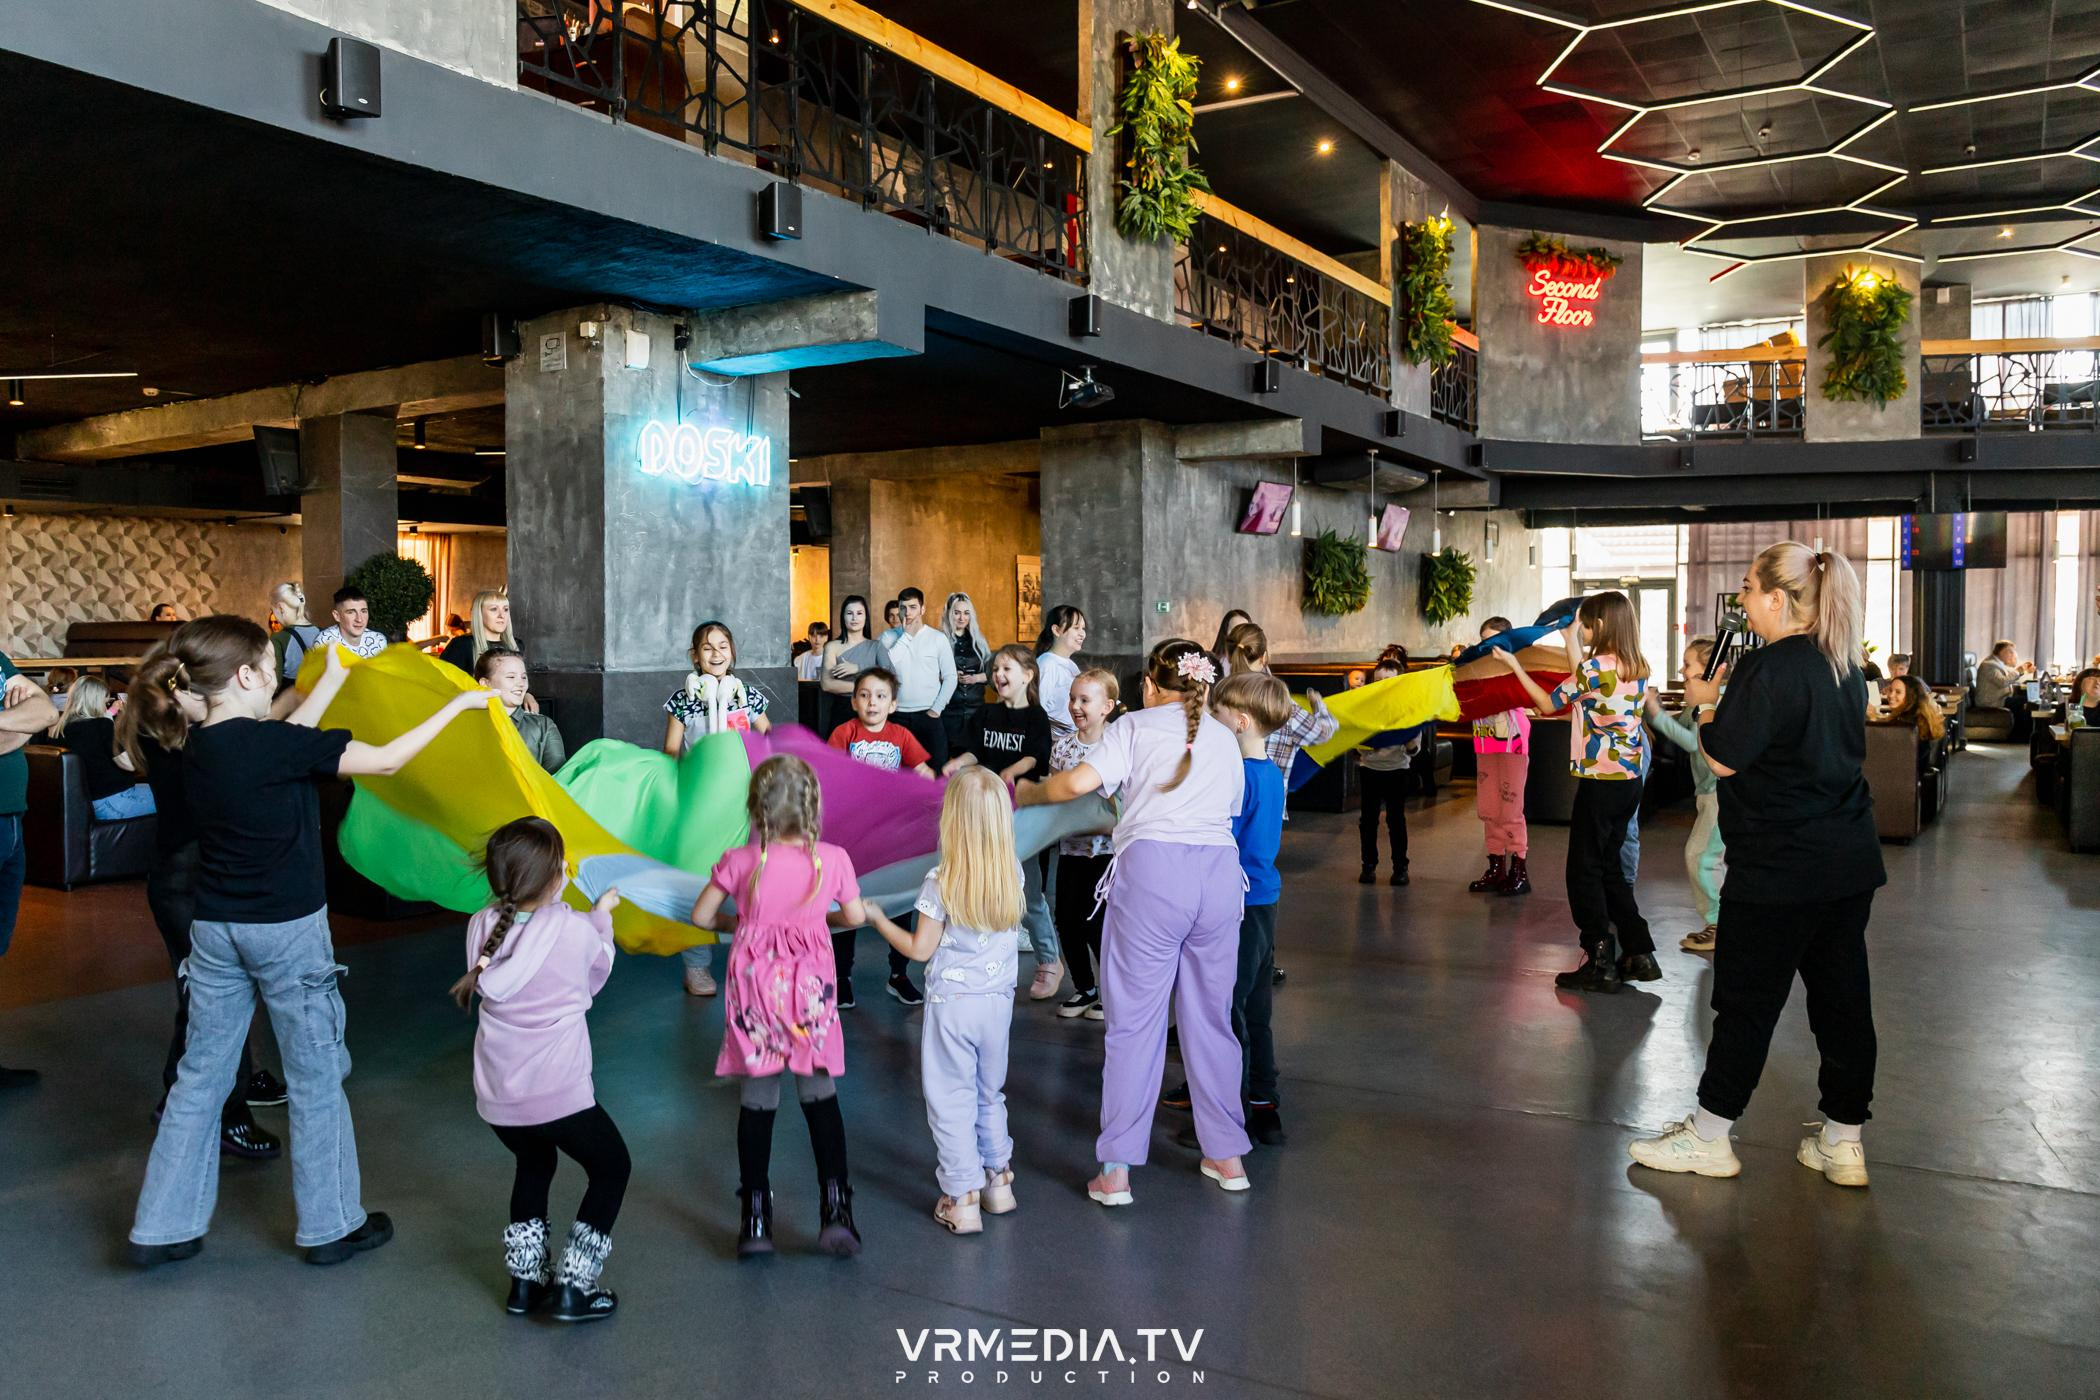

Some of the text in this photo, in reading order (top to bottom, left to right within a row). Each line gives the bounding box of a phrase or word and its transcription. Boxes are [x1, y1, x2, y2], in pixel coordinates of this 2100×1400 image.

[1529, 270, 1601, 300] Second
[1538, 297, 1593, 326] Floor
[640, 420, 770, 486] DOSKI
[984, 728, 1025, 752] EDNES
